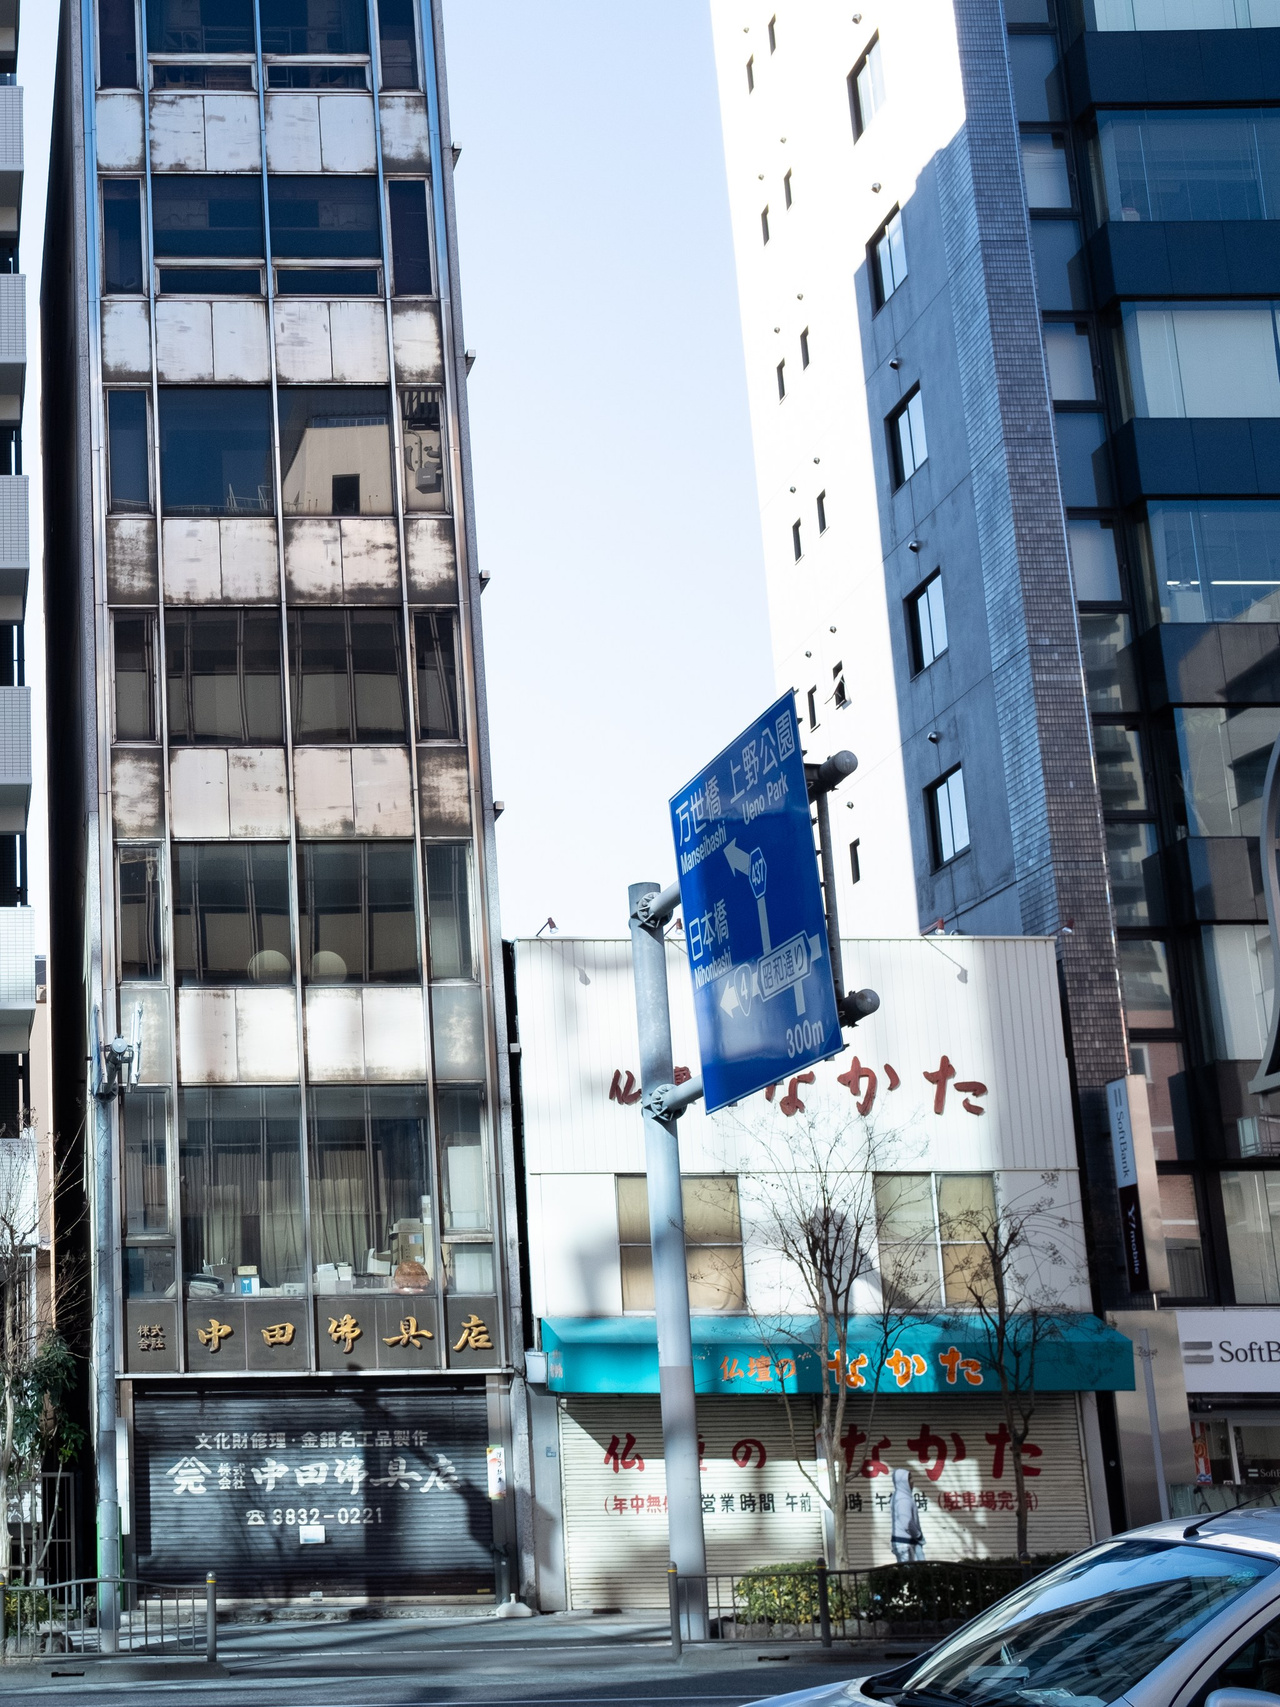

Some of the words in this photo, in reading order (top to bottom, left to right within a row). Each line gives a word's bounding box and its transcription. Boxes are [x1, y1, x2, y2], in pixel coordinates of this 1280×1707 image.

[675, 775, 722, 847] 万世橋
[730, 711, 796, 804] 上野公園
[742, 795, 765, 825] Ueno
[766, 772, 789, 806] Park
[680, 820, 727, 876] Manseibashi
[751, 859, 765, 886] 437
[689, 899, 730, 961] 日本橋
[694, 946, 732, 989] Nihonbashi
[740, 973, 748, 999] 4
[762, 943, 805, 989] 昭和通り
[786, 1020, 825, 1058] 300m
[1116, 1110, 1130, 1178] SoftBank
[1128, 1201, 1140, 1275] Y!mobile
[272, 1507, 384, 1526] 3832-0221
